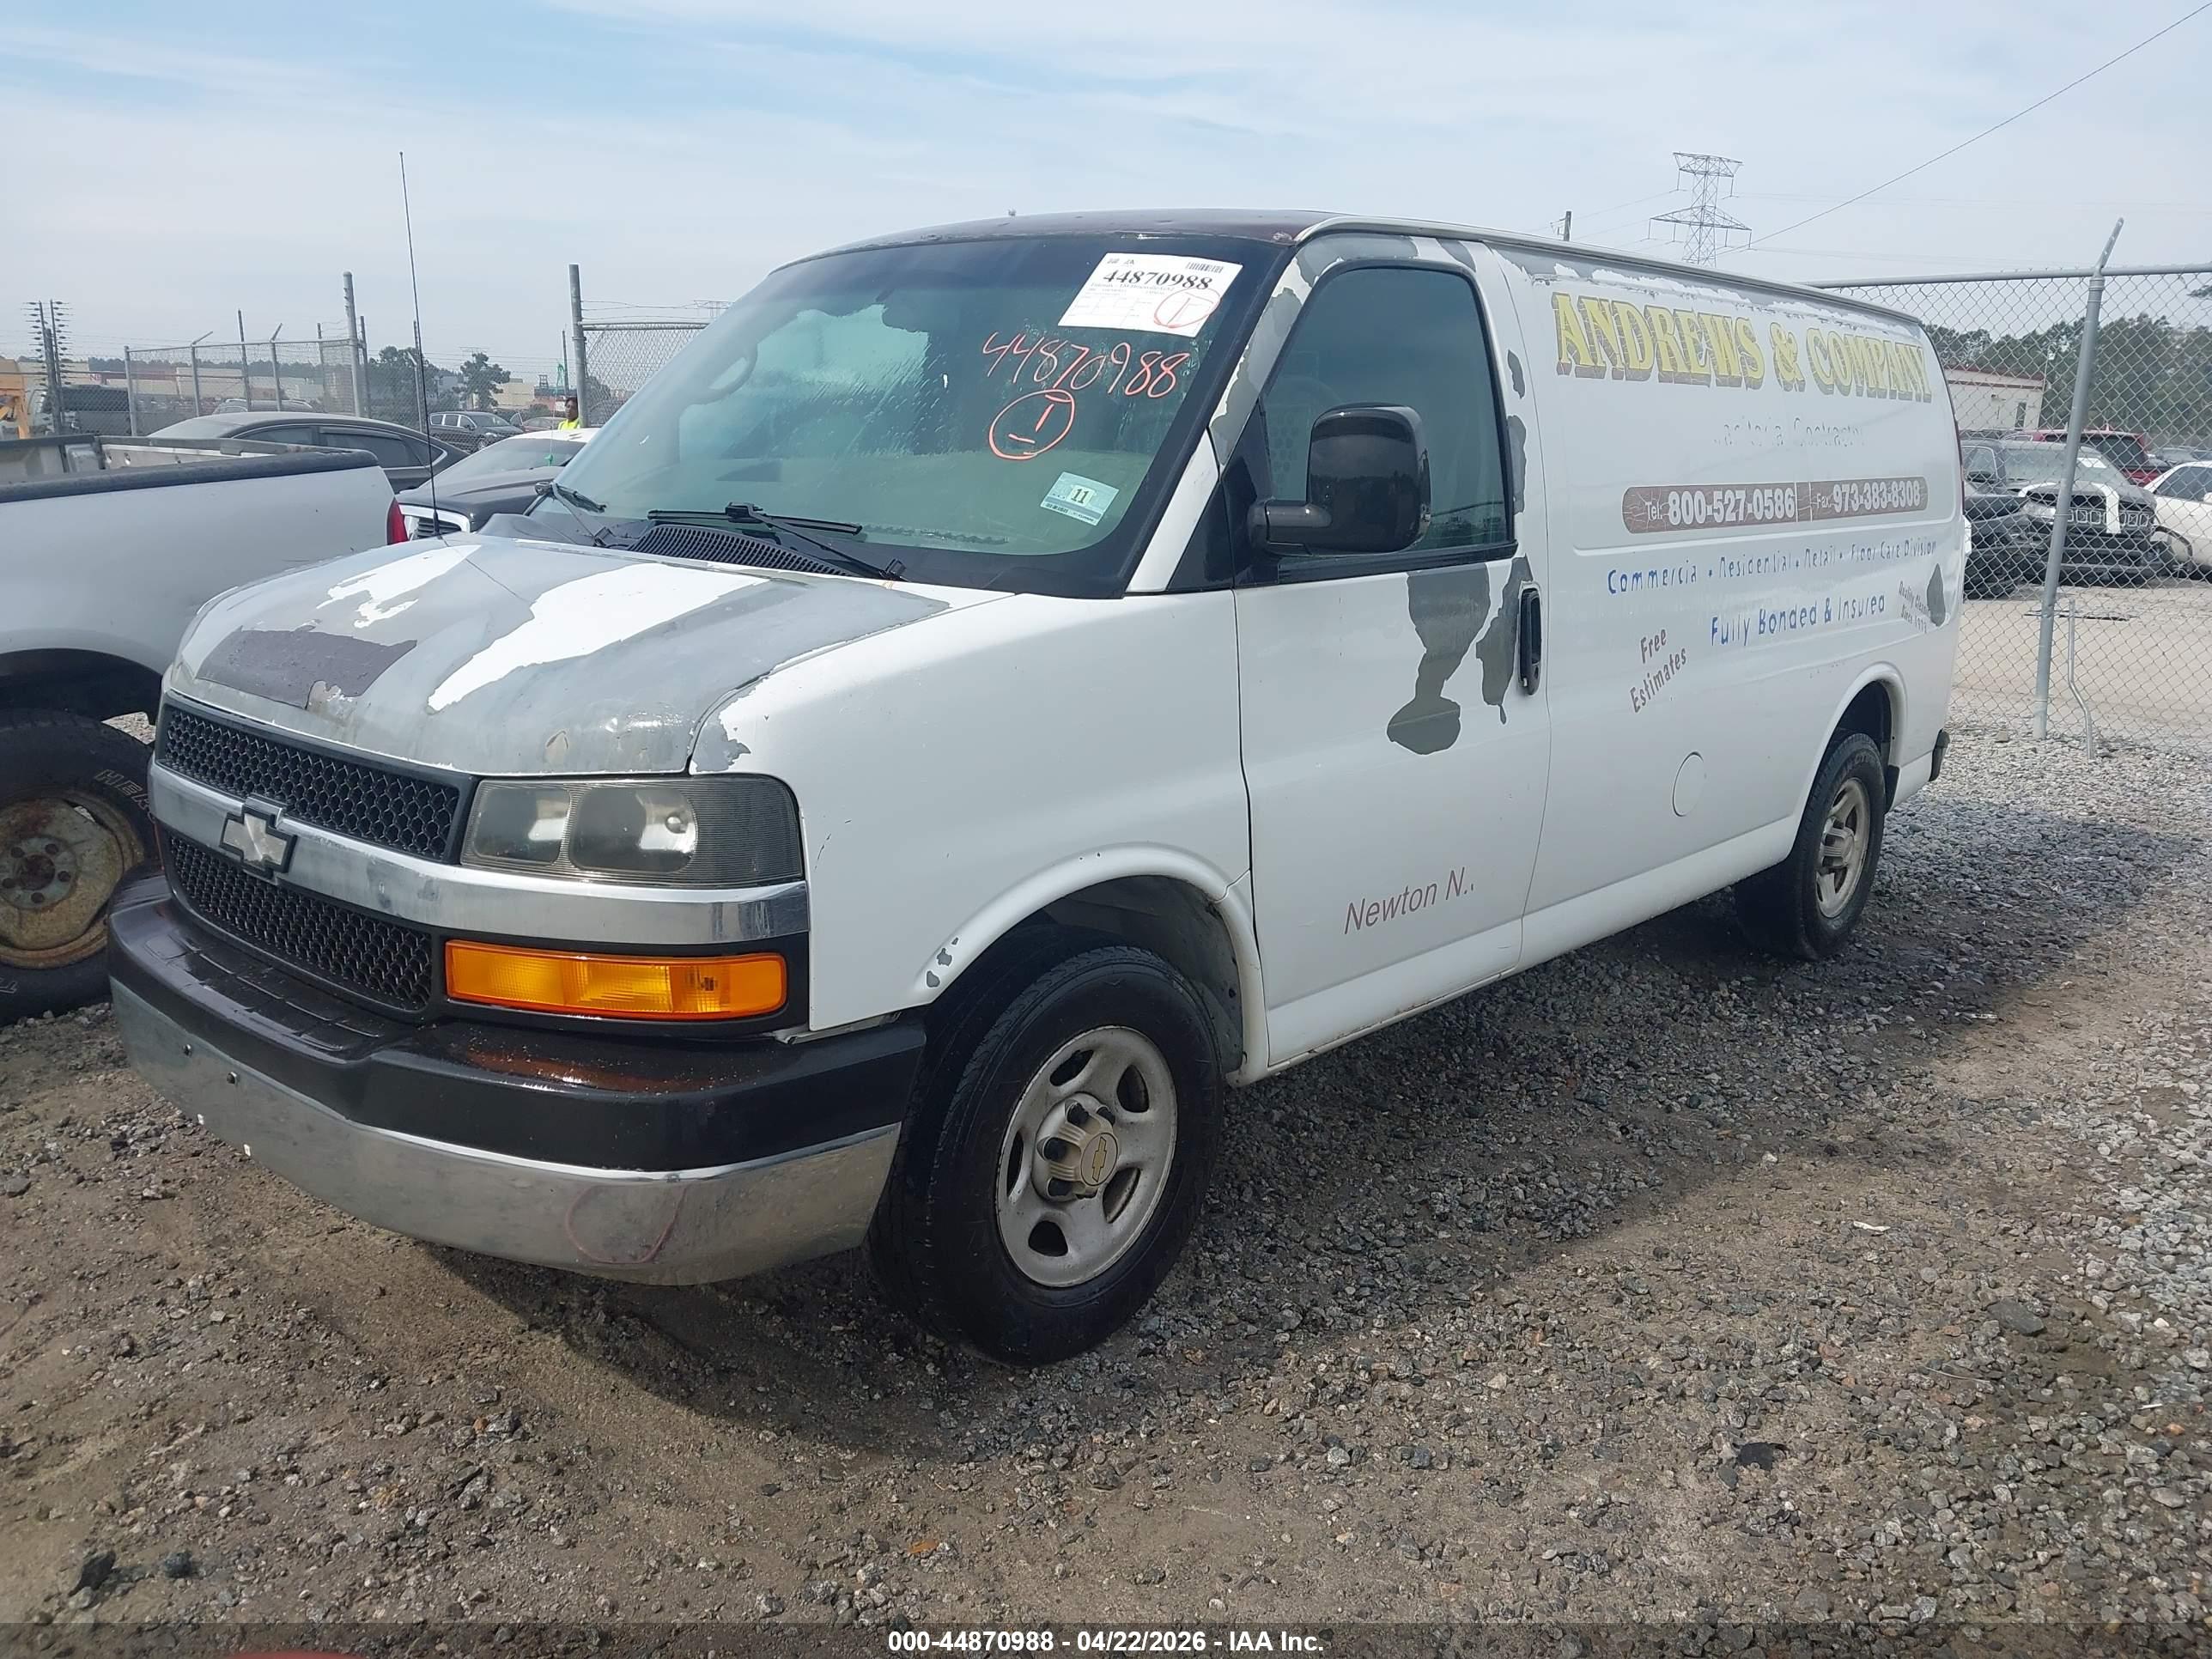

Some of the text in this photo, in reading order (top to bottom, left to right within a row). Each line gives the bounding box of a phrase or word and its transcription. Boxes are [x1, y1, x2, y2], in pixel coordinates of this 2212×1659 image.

[1103, 269, 1213, 290] 44870988
[982, 331, 1191, 398] 44870988
[1552, 291, 1933, 404] ANDREWS & COMPANY
[1070, 487, 1090, 505] 11
[1644, 487, 1796, 526] Tel. 800-527-0586
[1640, 629, 1667, 664] Free
[1711, 614, 1750, 647] Fully
[1758, 600, 1818, 635] Bonded
[1824, 597, 1832, 623] &
[1630, 647, 1686, 713] Estimates
[1344, 883, 1437, 934] Newton
